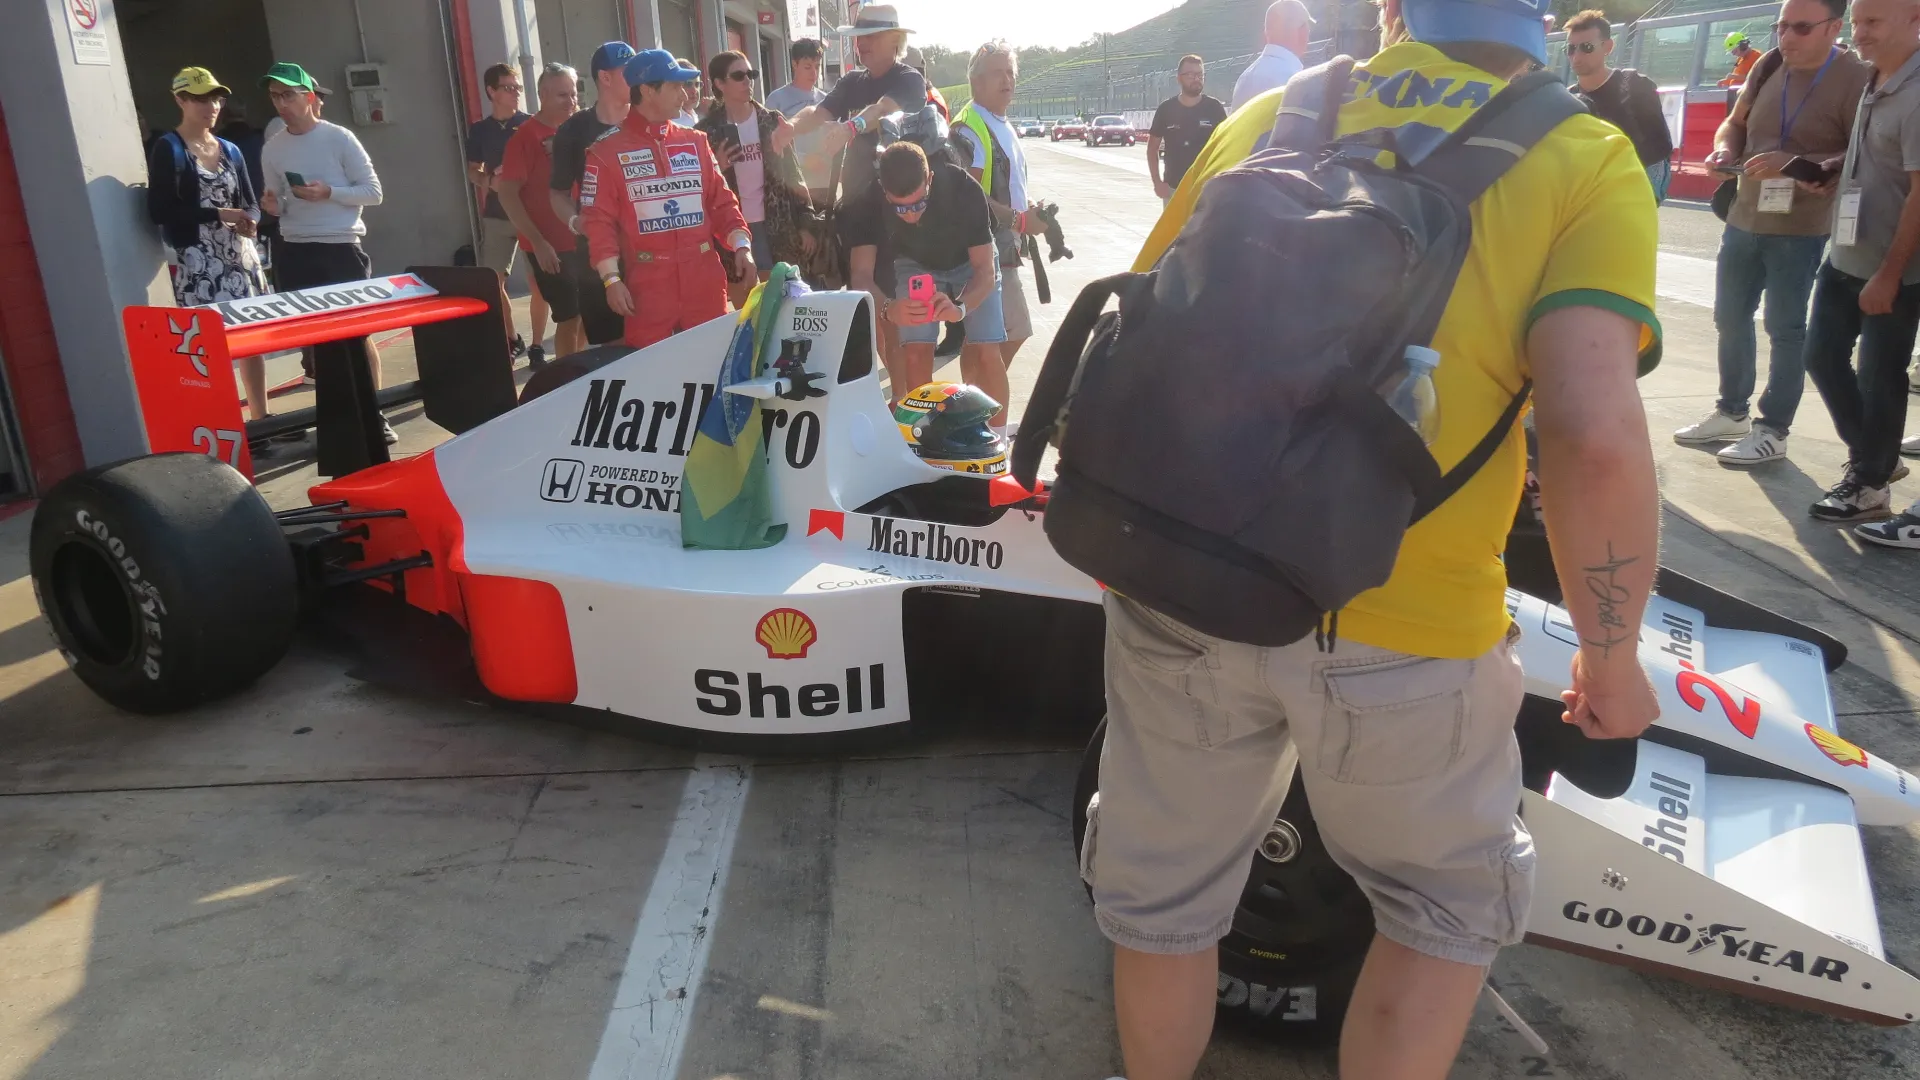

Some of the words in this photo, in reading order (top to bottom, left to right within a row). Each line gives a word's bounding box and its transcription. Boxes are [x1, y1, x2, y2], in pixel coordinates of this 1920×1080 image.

[670, 155, 698, 167] Marlboro
[625, 164, 655, 177] BOSS
[646, 180, 701, 193] HONDA
[642, 213, 701, 231] NACIONAL
[205, 284, 393, 326] Marlboro
[808, 307, 828, 317] Senna
[792, 317, 828, 332] BOSS
[193, 426, 243, 467] 27
[590, 465, 658, 483] POWERED
[660, 472, 678, 487] by
[867, 517, 1004, 571] Marlboro
[1660, 612, 1693, 661] hell
[694, 662, 886, 719] Shell
[1249, 947, 1287, 960] DYMAG
